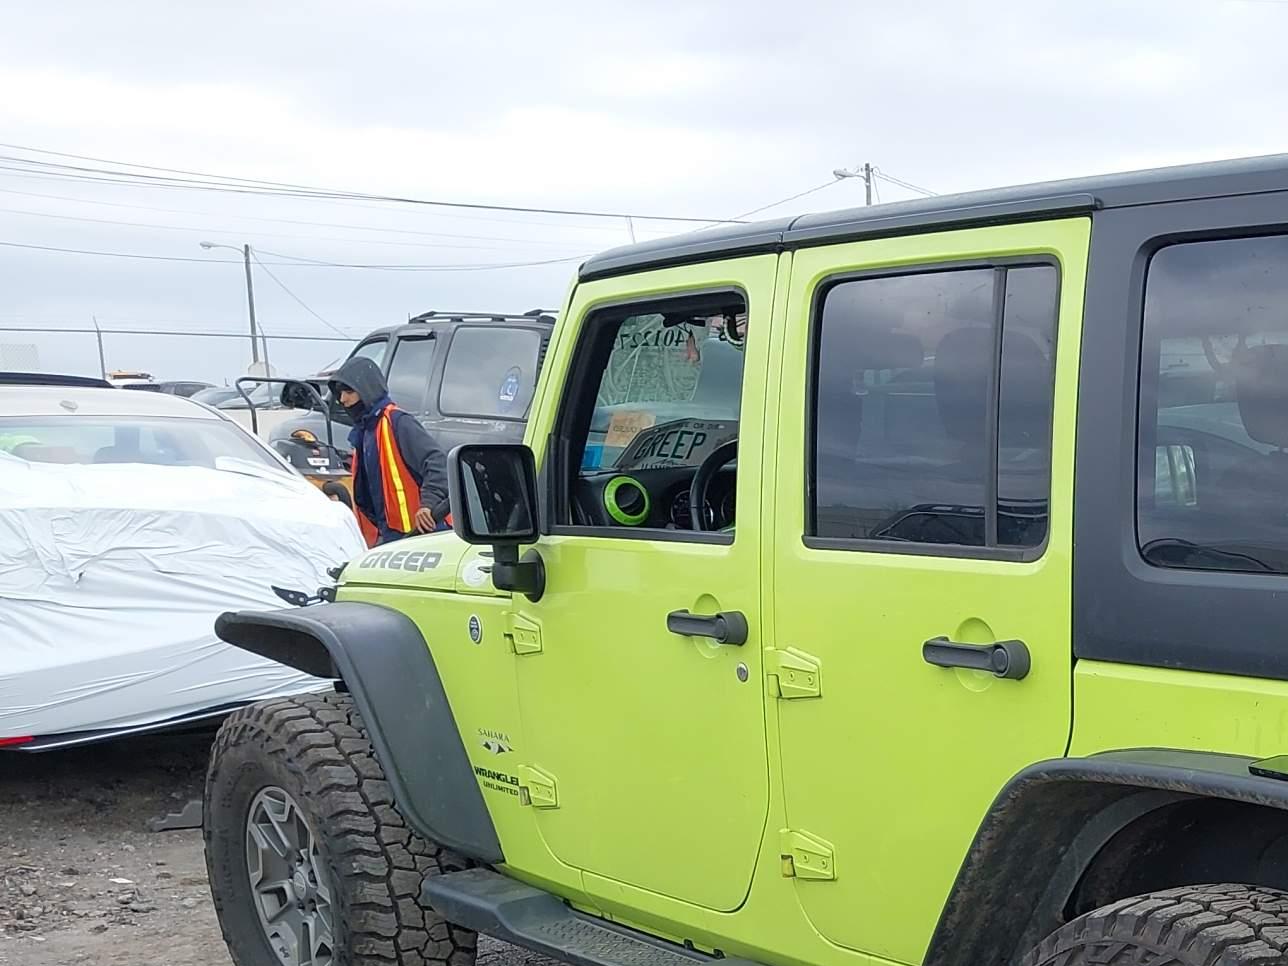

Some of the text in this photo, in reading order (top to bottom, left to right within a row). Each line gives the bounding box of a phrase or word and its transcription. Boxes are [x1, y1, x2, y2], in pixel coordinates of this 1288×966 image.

[633, 430, 706, 460] GREEP
[359, 551, 443, 573] GREEP
[478, 727, 510, 743] SAHARA
[482, 780, 519, 796] UNLIMITED
